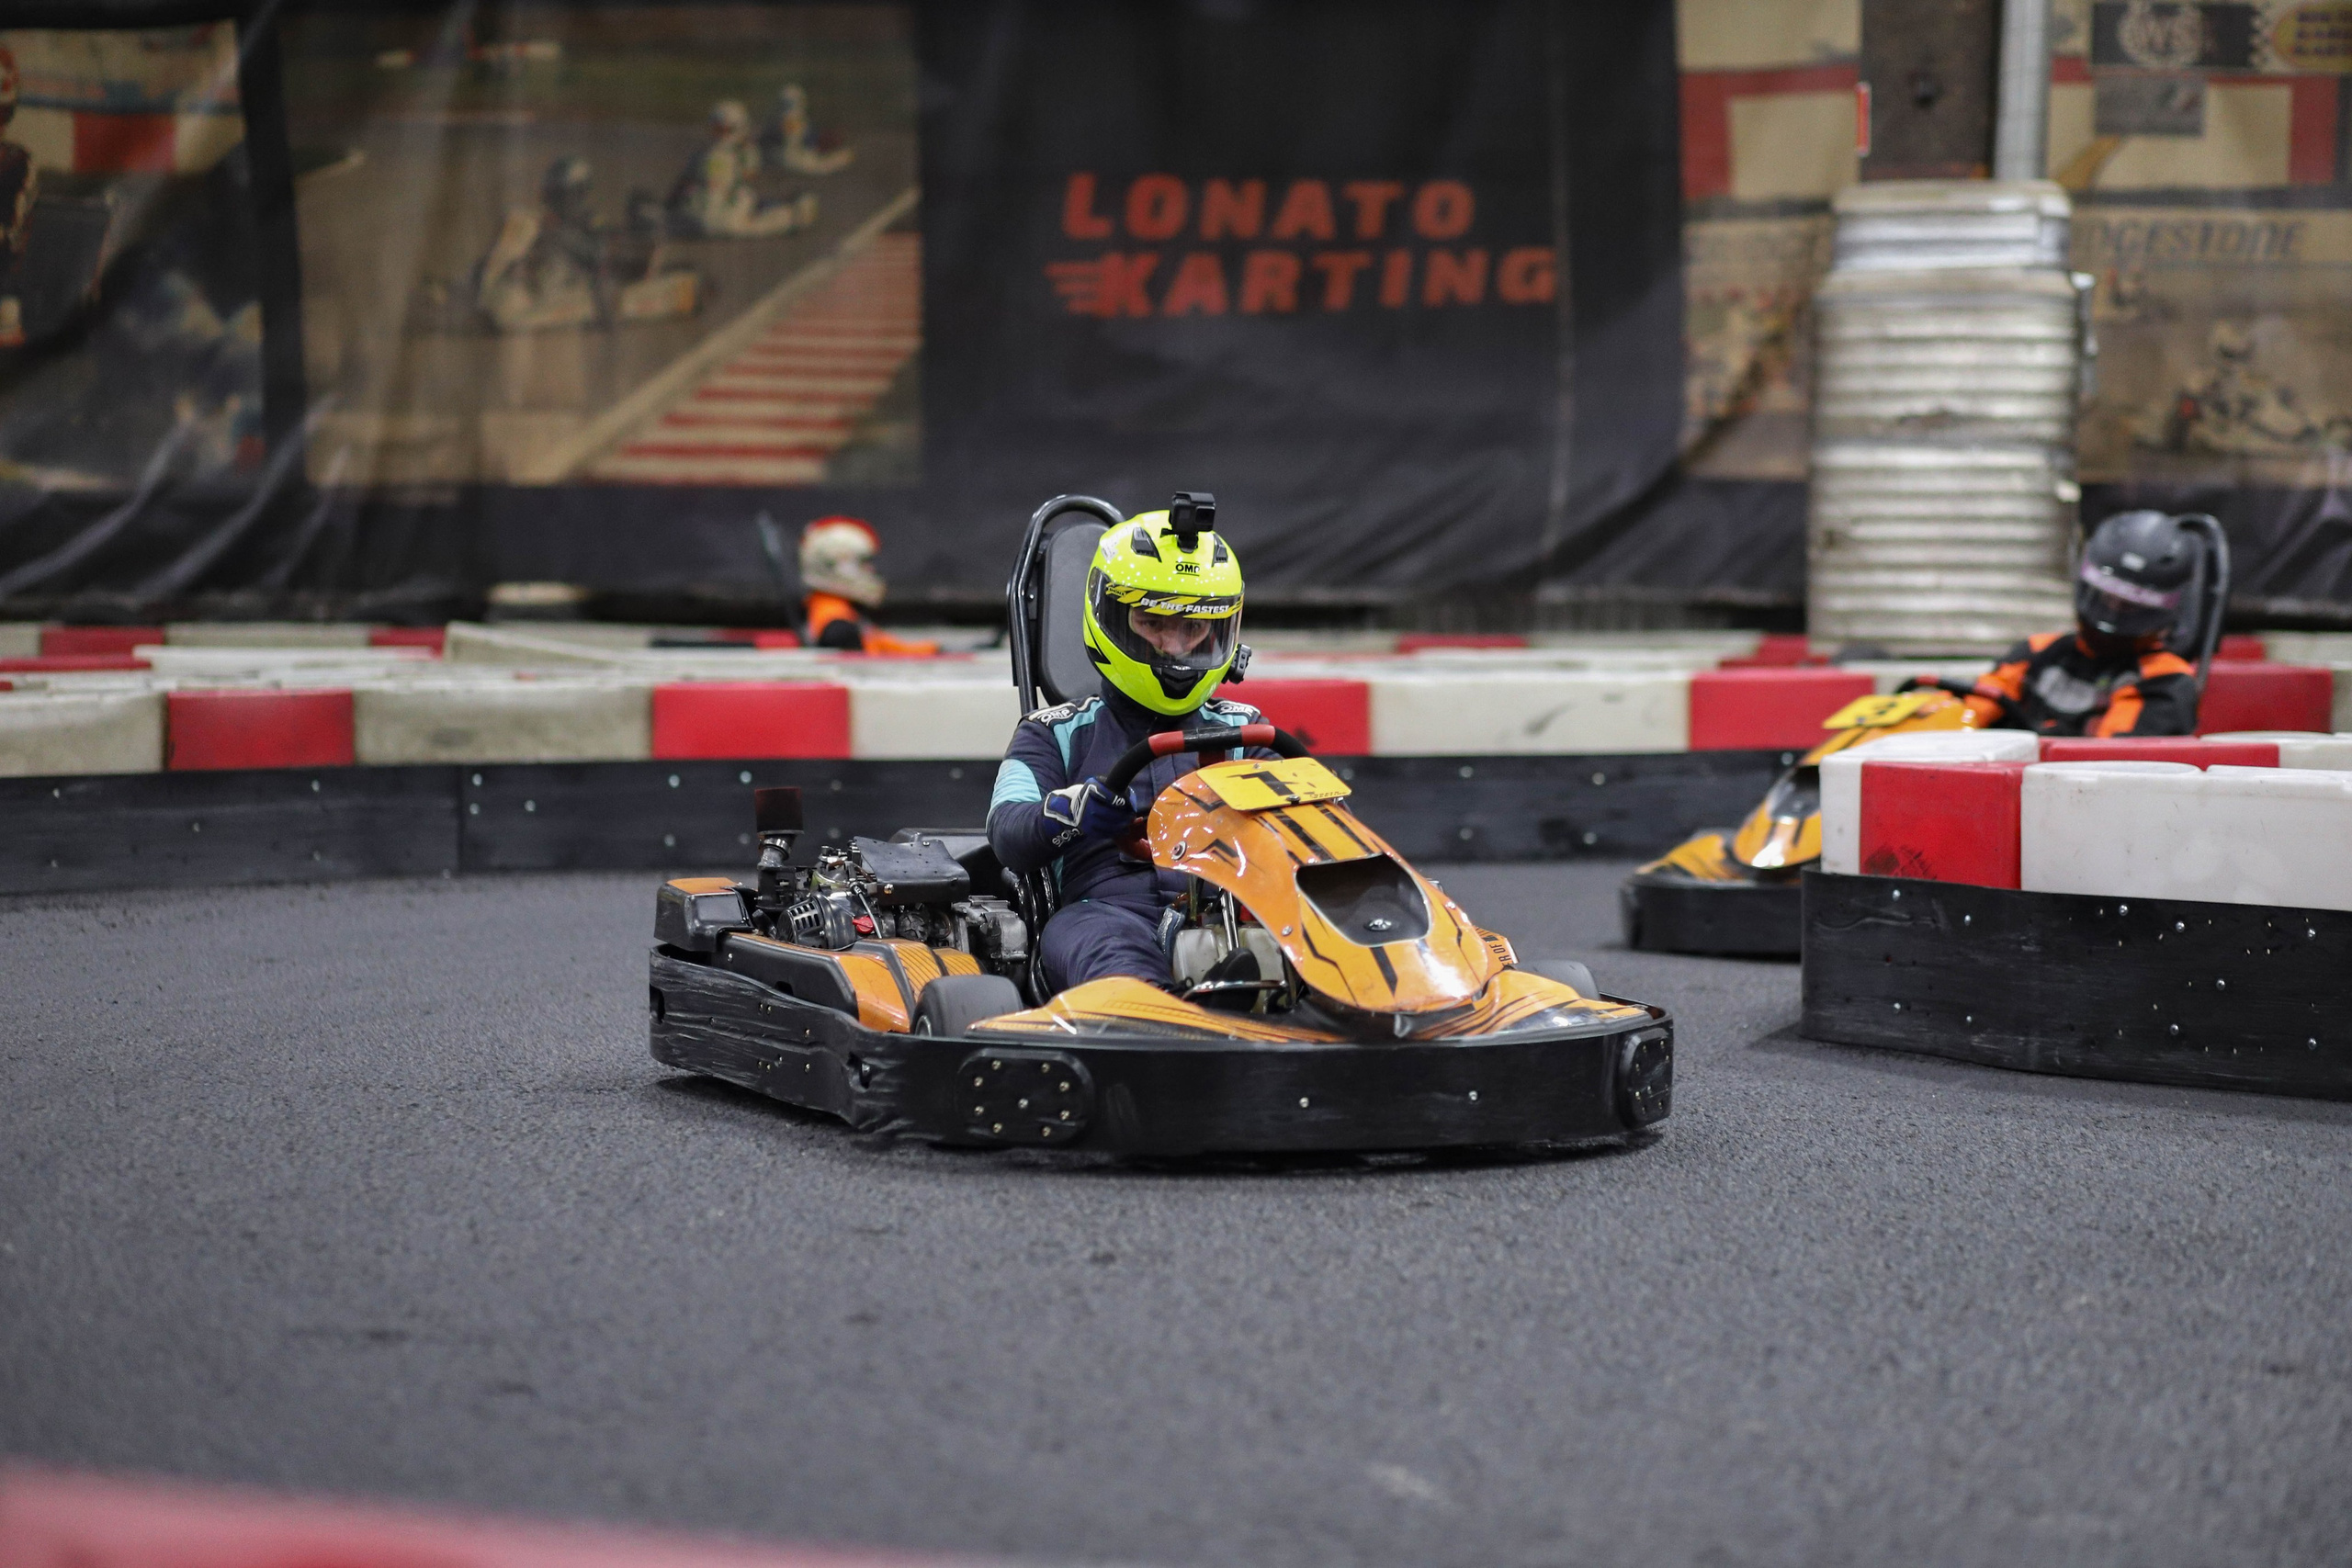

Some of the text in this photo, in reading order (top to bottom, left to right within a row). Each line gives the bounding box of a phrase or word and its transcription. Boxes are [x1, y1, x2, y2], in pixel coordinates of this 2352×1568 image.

[1062, 173, 1476, 241] LONATO
[1091, 246, 1558, 317] KARTING
[1140, 597, 1230, 615] BE THE FASTEST
[1040, 708, 1070, 723] OMP
[1488, 944, 1506, 954] OF
